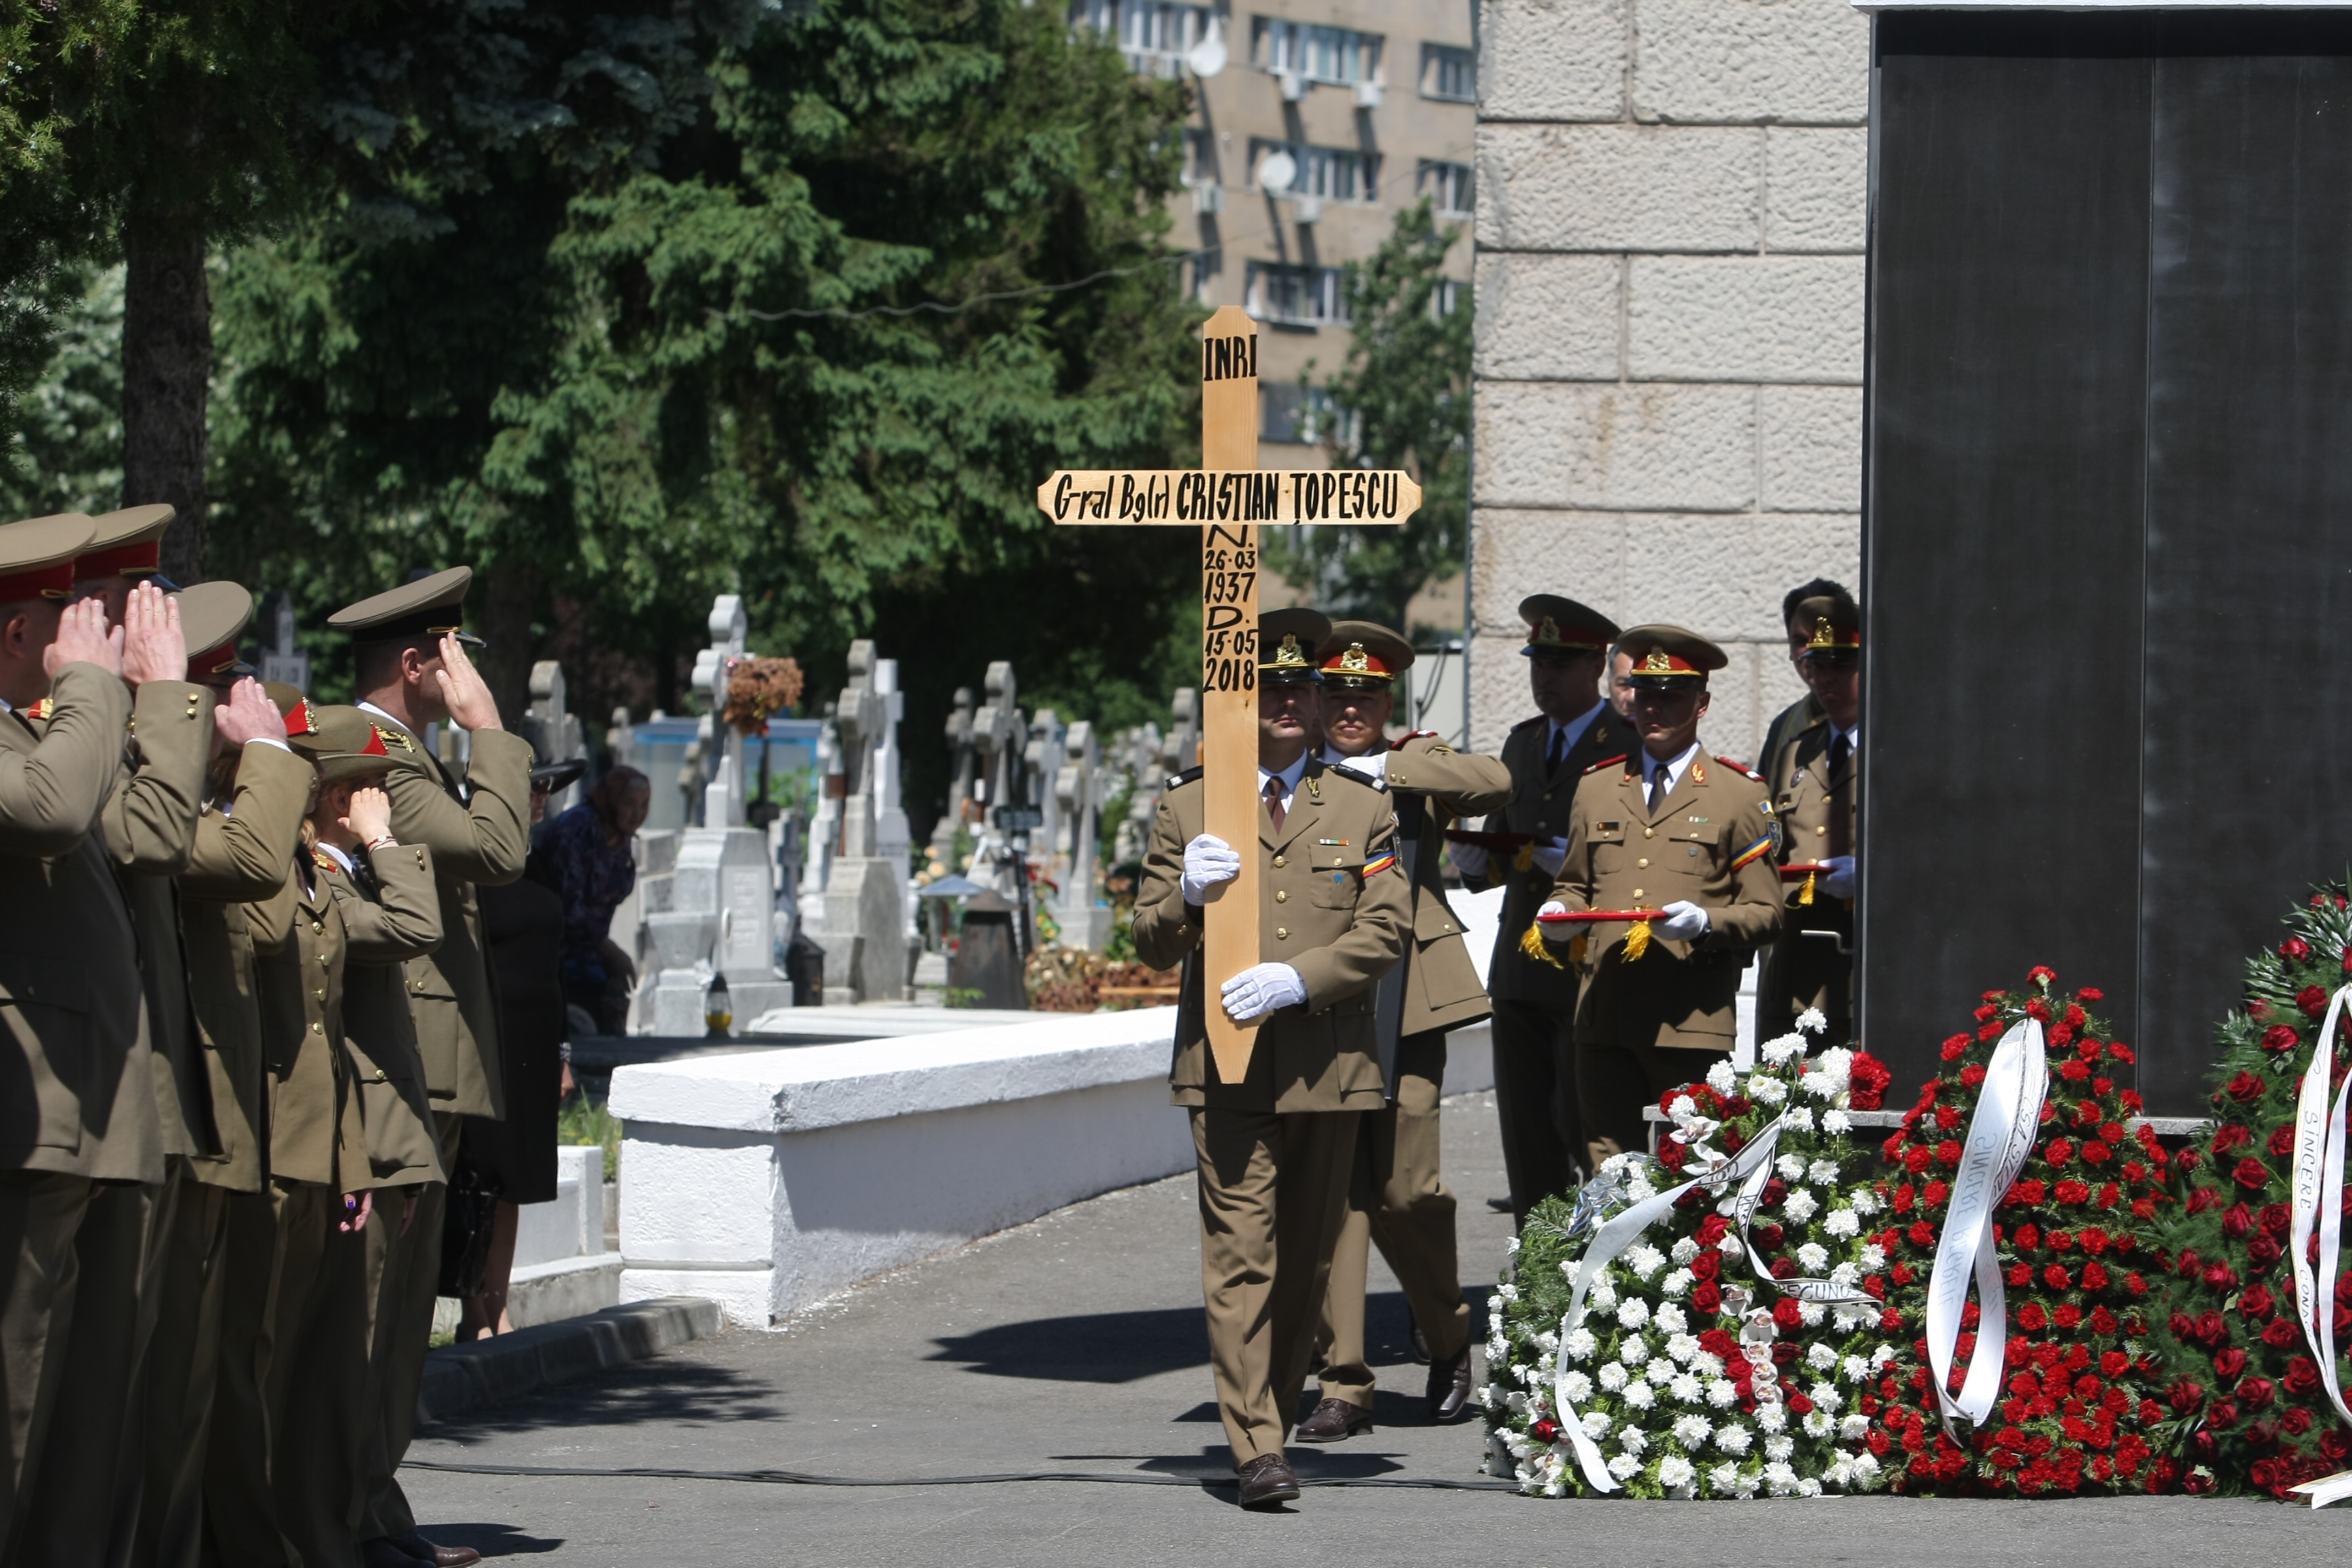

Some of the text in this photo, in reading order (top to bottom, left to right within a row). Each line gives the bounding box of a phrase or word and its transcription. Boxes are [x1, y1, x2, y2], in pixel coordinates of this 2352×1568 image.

[1204, 334, 1258, 381] INRI
[1177, 472, 1279, 521] CRISTIAN
[1206, 524, 1254, 548] N.
[1204, 572, 1256, 604] 1937
[1206, 606, 1250, 630] D.
[1203, 657, 1255, 693] 2018
